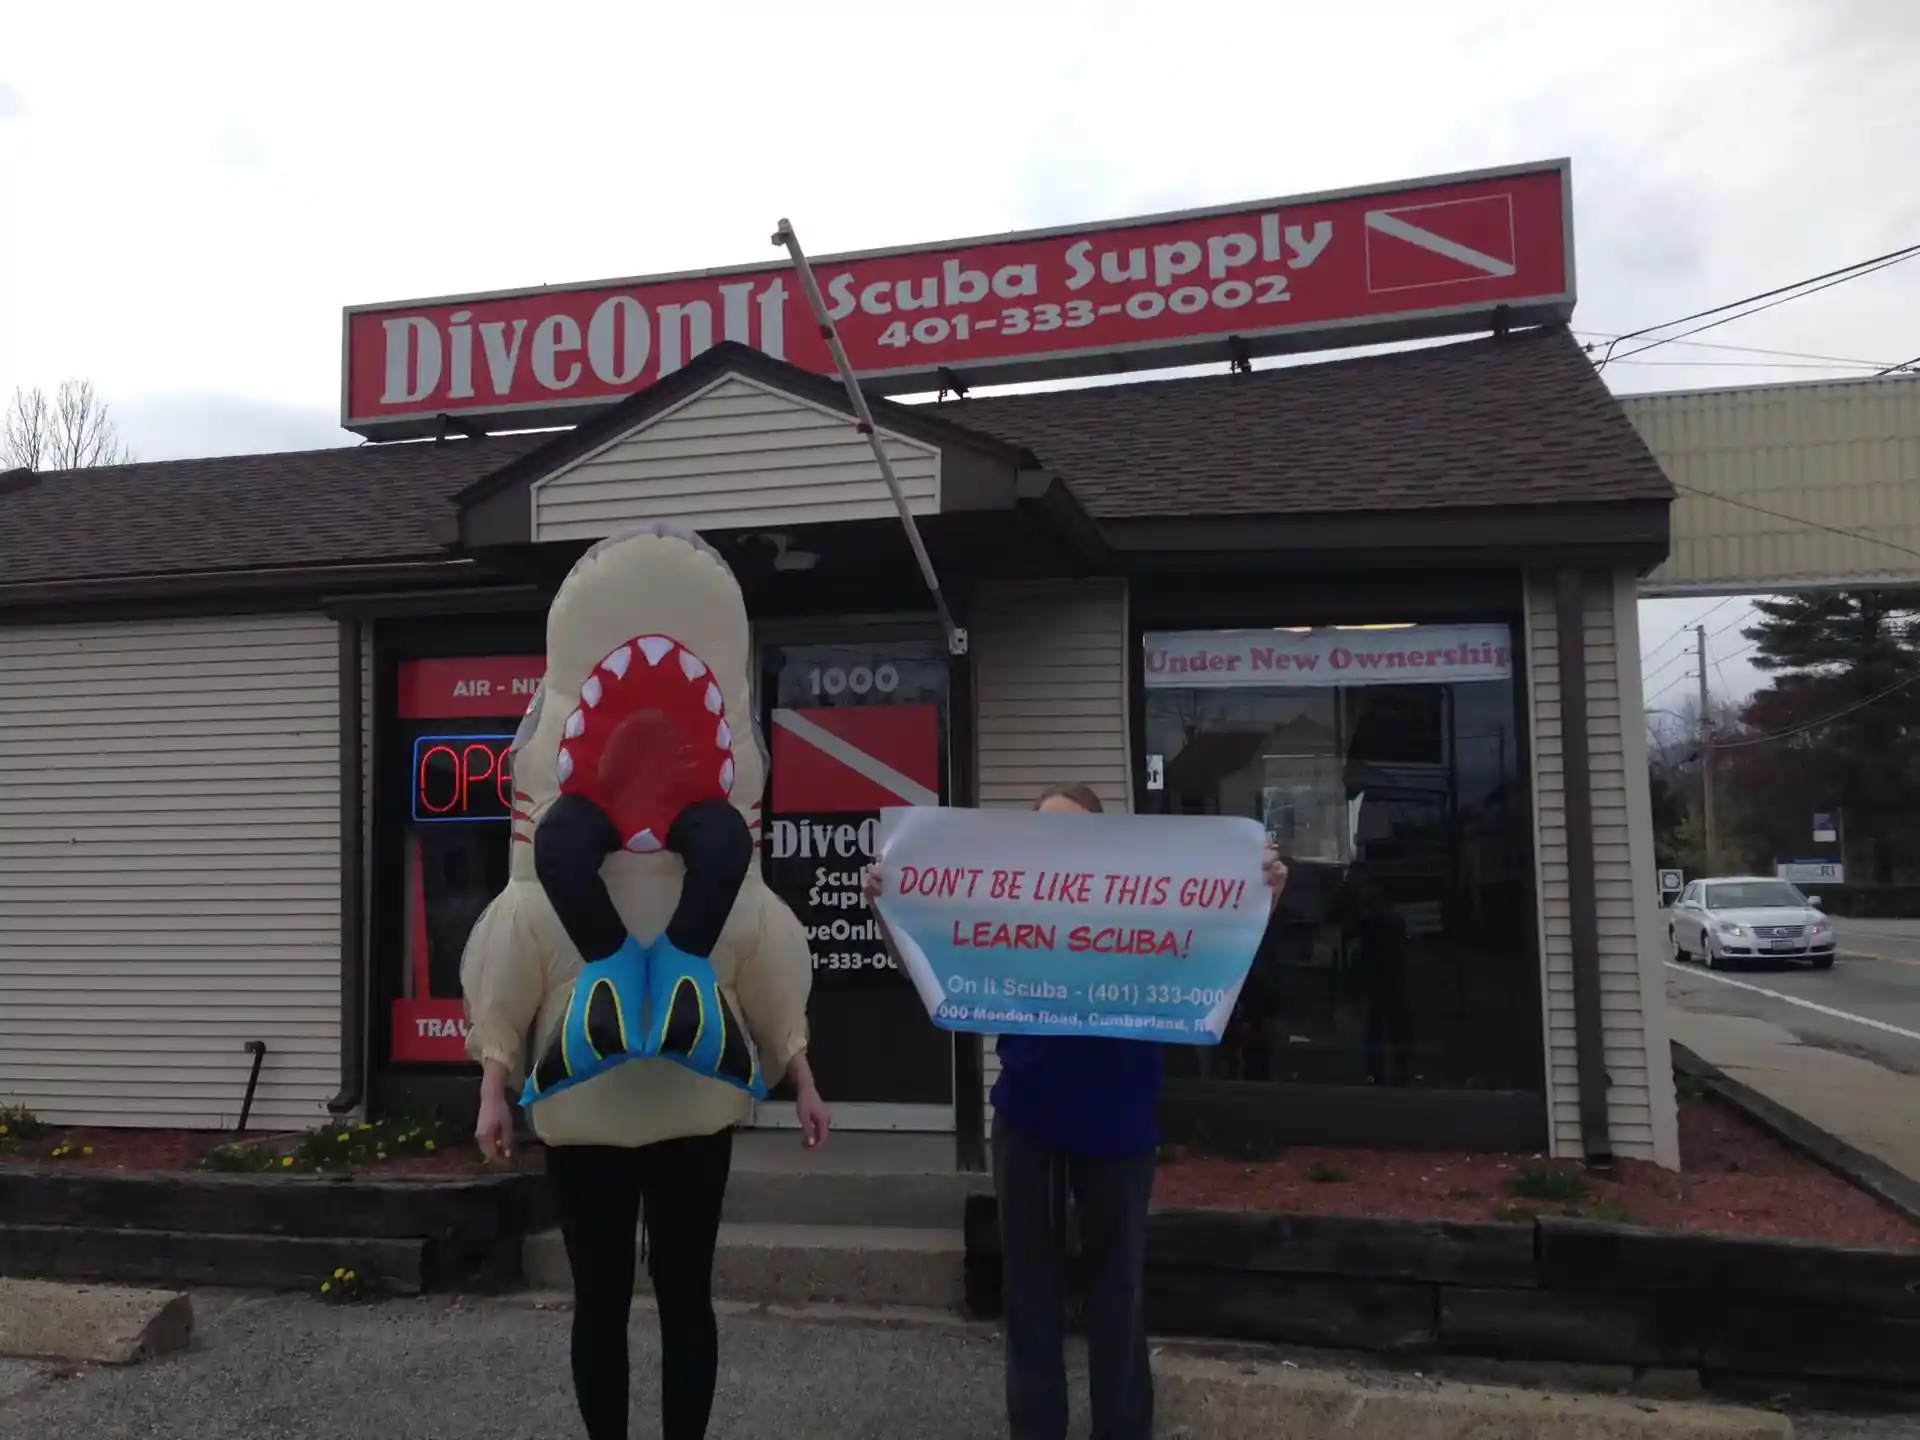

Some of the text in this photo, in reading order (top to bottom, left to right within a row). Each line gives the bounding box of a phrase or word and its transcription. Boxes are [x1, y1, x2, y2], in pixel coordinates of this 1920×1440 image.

[829, 213, 1333, 320] Scuba Supply
[877, 275, 1292, 349] 401-333-0002
[379, 277, 788, 404] DiveOnIt
[1145, 641, 1512, 674] Under New Ownership
[452, 680, 491, 697] AIR
[808, 665, 900, 695] 1000
[900, 866, 1246, 910] DON'T BE LIKE THIS GUY!
[952, 920, 1193, 960] LEARN SCUBA!
[947, 975, 976, 995] On
[983, 976, 998, 996] It
[1003, 978, 1068, 1000] Scuba
[1087, 983, 1139, 1005] (401)
